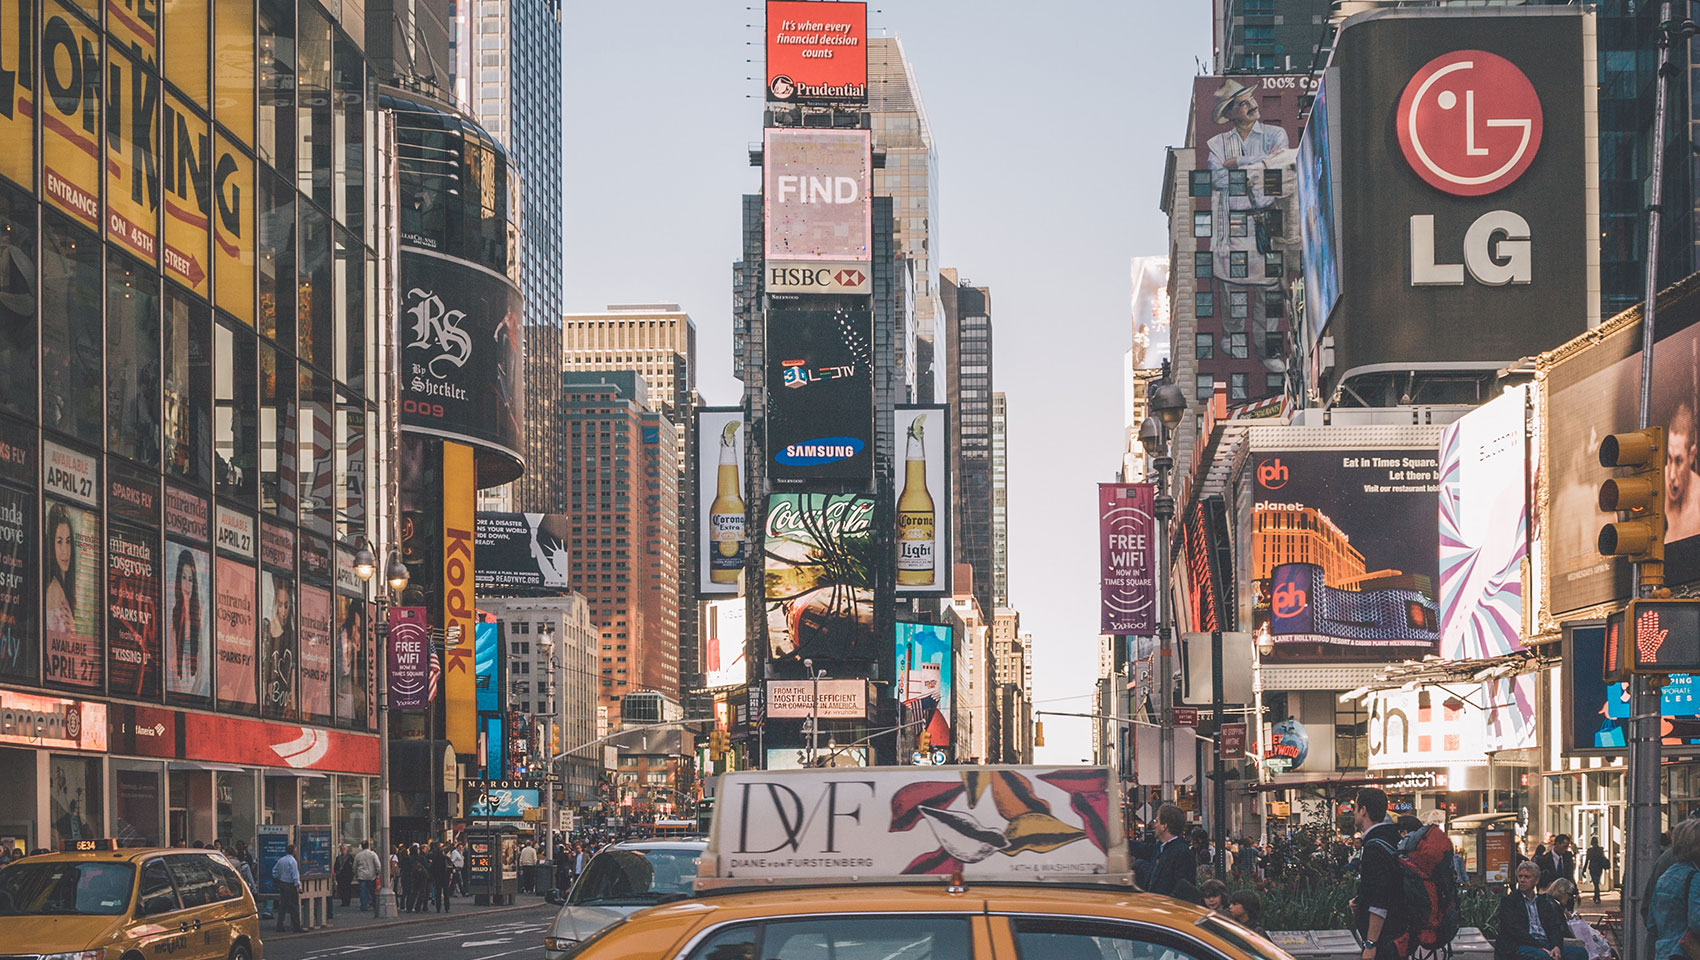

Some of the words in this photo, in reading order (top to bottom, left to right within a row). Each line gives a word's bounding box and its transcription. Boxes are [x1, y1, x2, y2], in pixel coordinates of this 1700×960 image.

[798, 20, 823, 31] when
[825, 24, 851, 34] every
[777, 33, 818, 44] financial
[820, 34, 858, 45] decision
[802, 49, 833, 58] counts
[796, 82, 865, 96] Prudential
[1262, 77, 1295, 89] 100%
[131, 40, 241, 240] KING
[778, 175, 859, 204] FIND
[48, 174, 97, 219] ENTRANCE
[111, 215, 126, 237] ON
[131, 227, 153, 254] 45TH
[164, 248, 190, 277] STREET
[1410, 209, 1532, 286] LG
[770, 268, 831, 287] HSBC
[412, 363, 426, 377] By
[411, 376, 466, 400] Sheckler
[786, 445, 854, 458] SAMSUNG
[52, 451, 89, 475] AVAILABLE
[1343, 458, 1359, 467] Eat
[1361, 458, 1370, 467] in
[1372, 458, 1401, 467] Times
[1402, 458, 1438, 469] Square.
[47, 466, 78, 494] APRIL
[80, 477, 92, 498] 27
[1257, 458, 1289, 490] ph
[1389, 471, 1405, 480] Let
[1406, 471, 1431, 480] there
[112, 482, 140, 505] SPARKS
[141, 493, 152, 509] FLY
[167, 492, 207, 520] miranda
[1255, 501, 1304, 512] planet
[166, 510, 207, 538] cosgrove
[110, 534, 150, 560] miranda
[218, 527, 240, 548] APRIL
[241, 535, 250, 551] 27
[1109, 534, 1146, 550] FREE
[1111, 551, 1144, 567] WIFI
[496, 576, 539, 584] READYNYC.ORG
[1104, 578, 1125, 586] TIMES
[1126, 578, 1152, 586] SQUARE
[1110, 622, 1147, 630] YAHOO!
[51, 638, 87, 656] AVAILABLE
[395, 641, 421, 653] FREE
[1294, 635, 1330, 643] HOLLYWOOD
[396, 653, 419, 664] WIFI
[45, 652, 77, 680] APRIL
[80, 659, 94, 682] 27
[1386, 771, 1436, 788] swatch
[731, 781, 876, 854] DVF
[76, 841, 96, 850] 6E34
[730, 859, 766, 867] DIANE
[787, 858, 873, 867] FURSTENBERG
